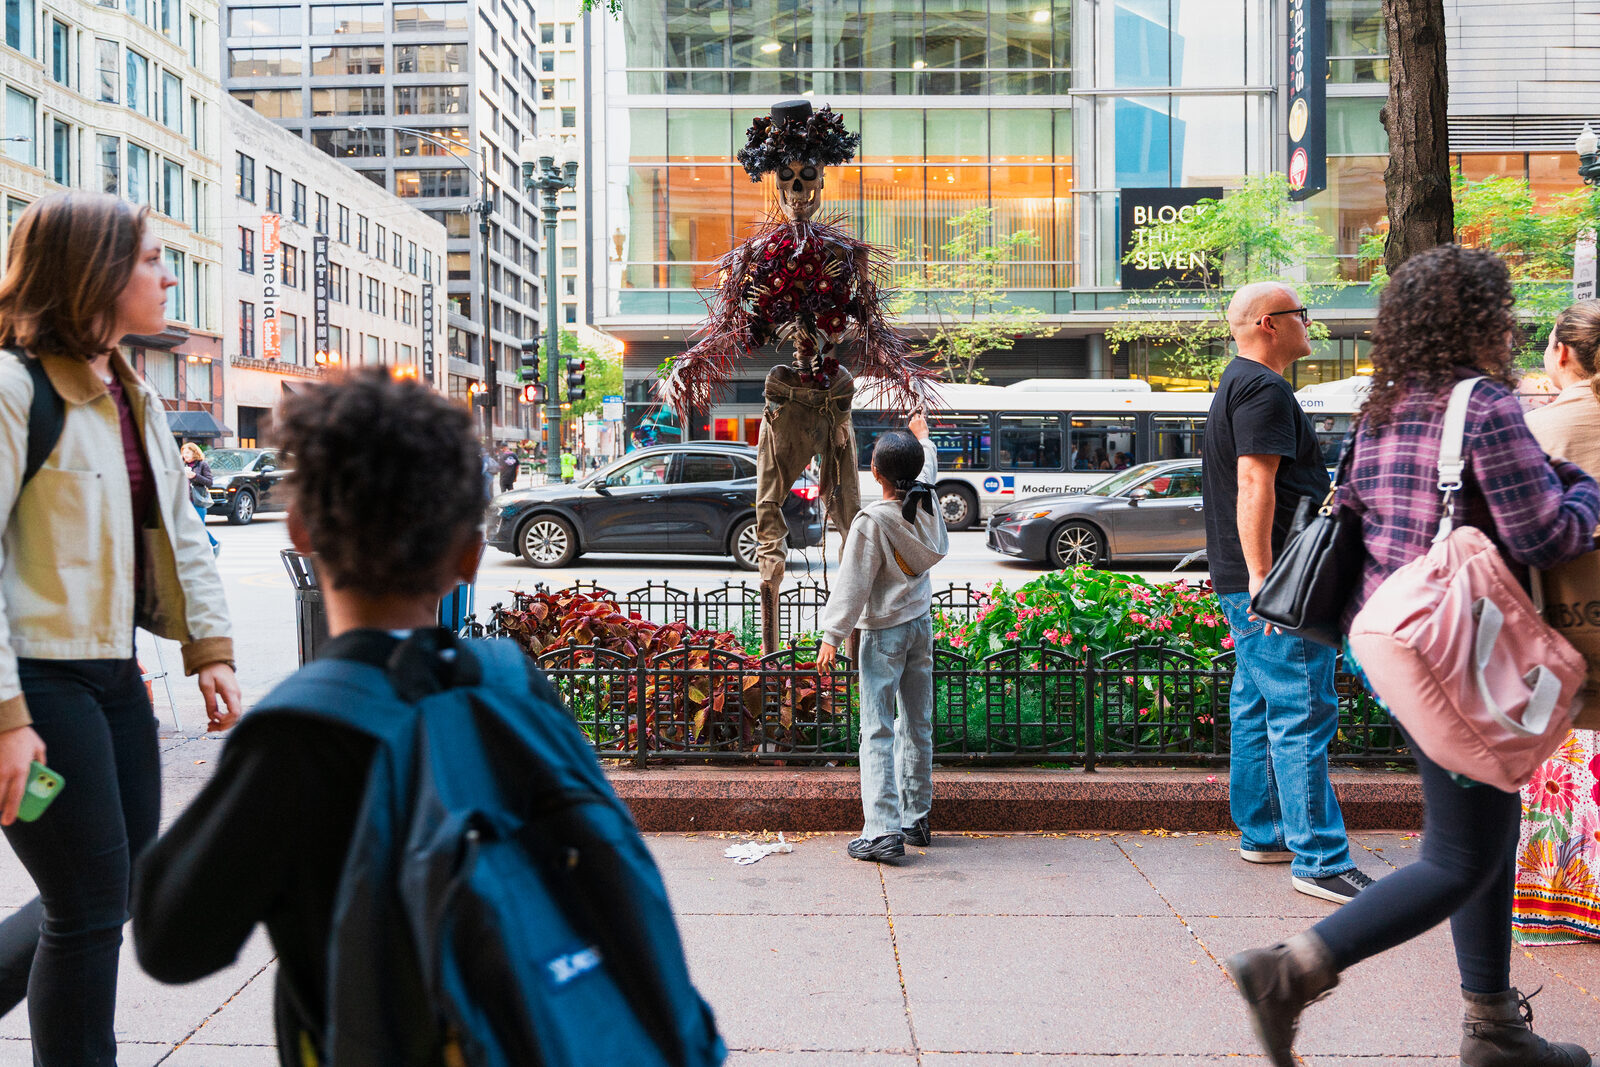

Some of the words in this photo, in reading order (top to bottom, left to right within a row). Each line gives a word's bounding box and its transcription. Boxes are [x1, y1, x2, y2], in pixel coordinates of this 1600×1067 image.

[1134, 228, 1209, 247] THI
[1135, 251, 1206, 270] SEVEN
[263, 254, 280, 319] media
[264, 322, 275, 351] School
[423, 287, 433, 375] FOODHALL
[1022, 485, 1062, 493] Modern
